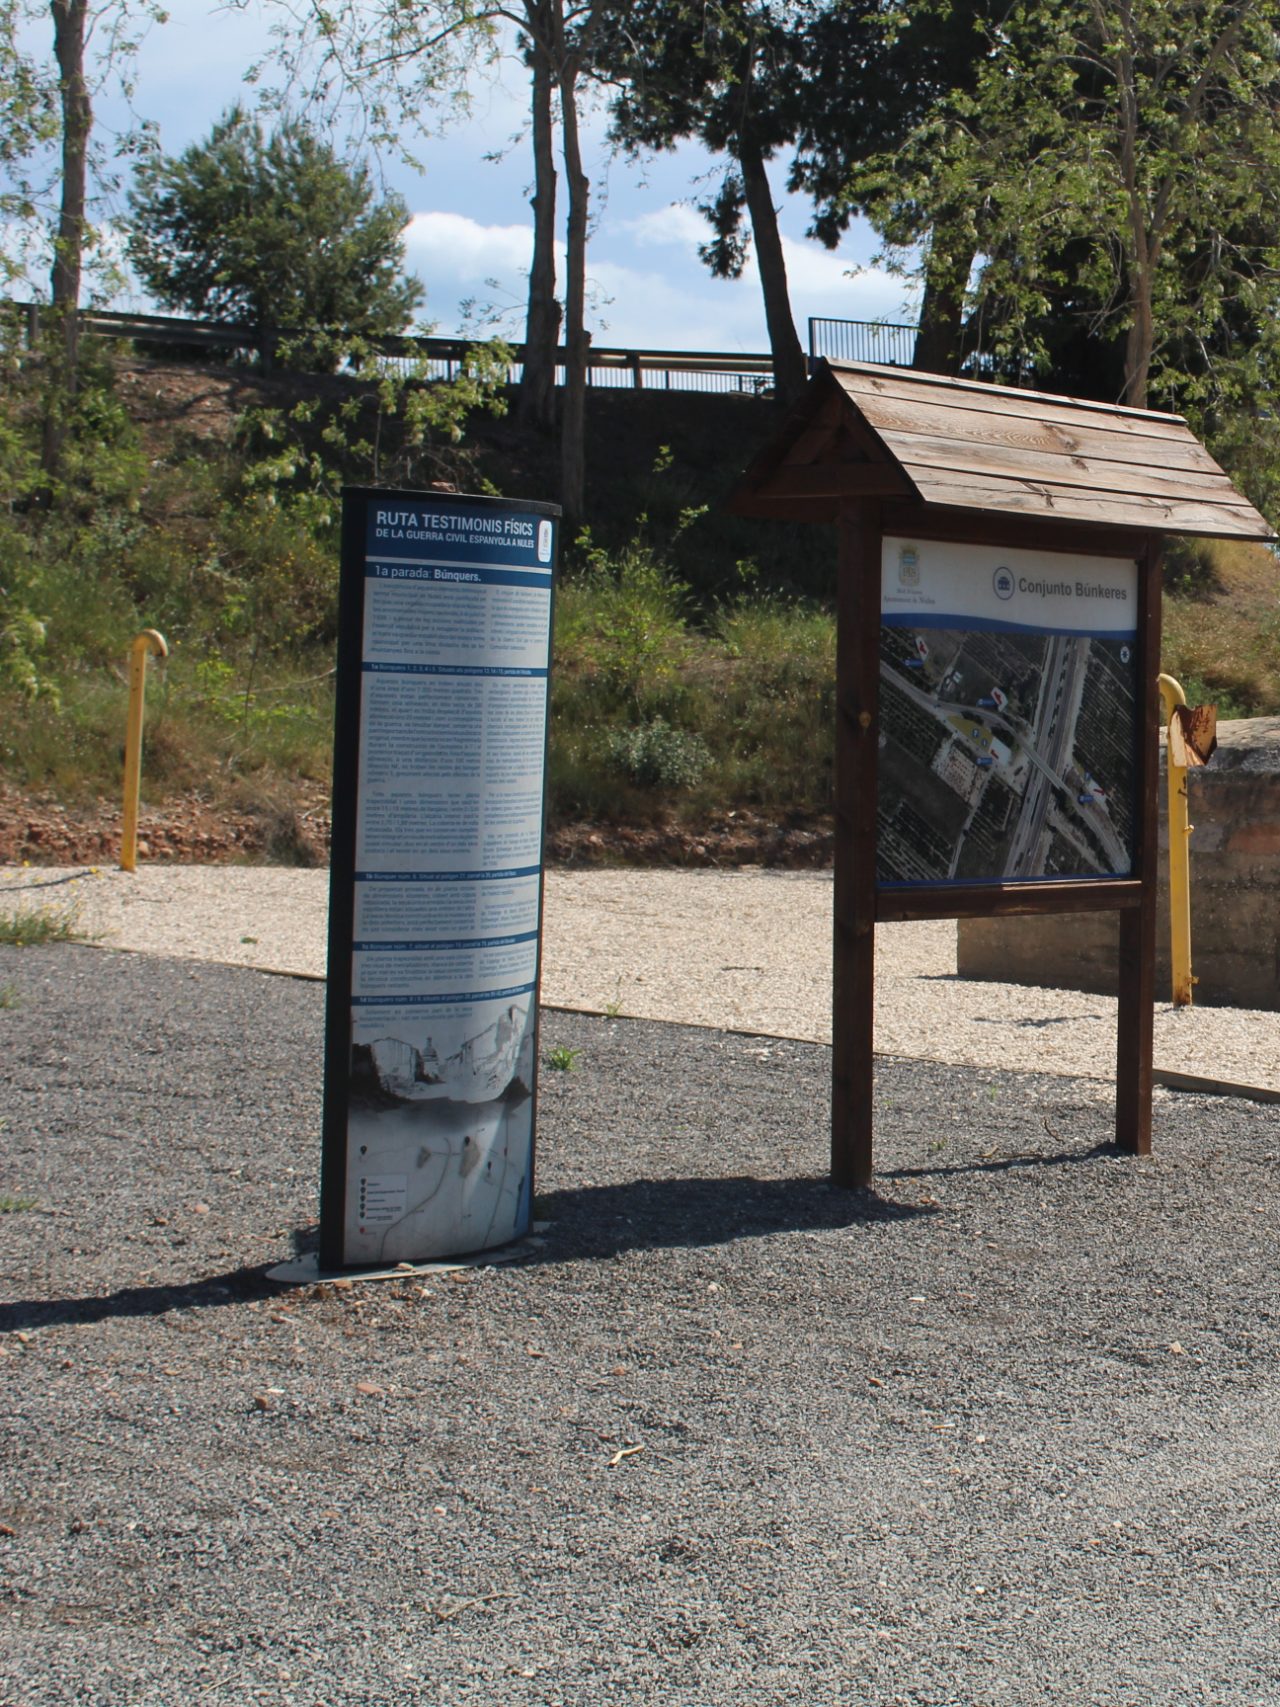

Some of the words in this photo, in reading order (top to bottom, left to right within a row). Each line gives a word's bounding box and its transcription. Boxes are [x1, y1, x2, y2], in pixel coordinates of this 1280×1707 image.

[377, 511, 418, 527] RUTA
[422, 514, 502, 533] TESTIMONIS
[504, 517, 533, 536] FÍSICS
[376, 528, 388, 538] DE
[391, 529, 404, 539] LA
[406, 530, 444, 541] GUERRA
[445, 532, 467, 543] CIVIL
[469, 534, 511, 546] ESPANYOLA
[511, 538, 517, 547] A
[517, 538, 535, 548] NULES
[376, 565, 388, 576] 1a
[391, 566, 433, 579] parada:
[434, 569, 481, 583] Búnquers.
[1018, 577, 1072, 597] Conjunto
[1075, 582, 1127, 601] Búnkeres
